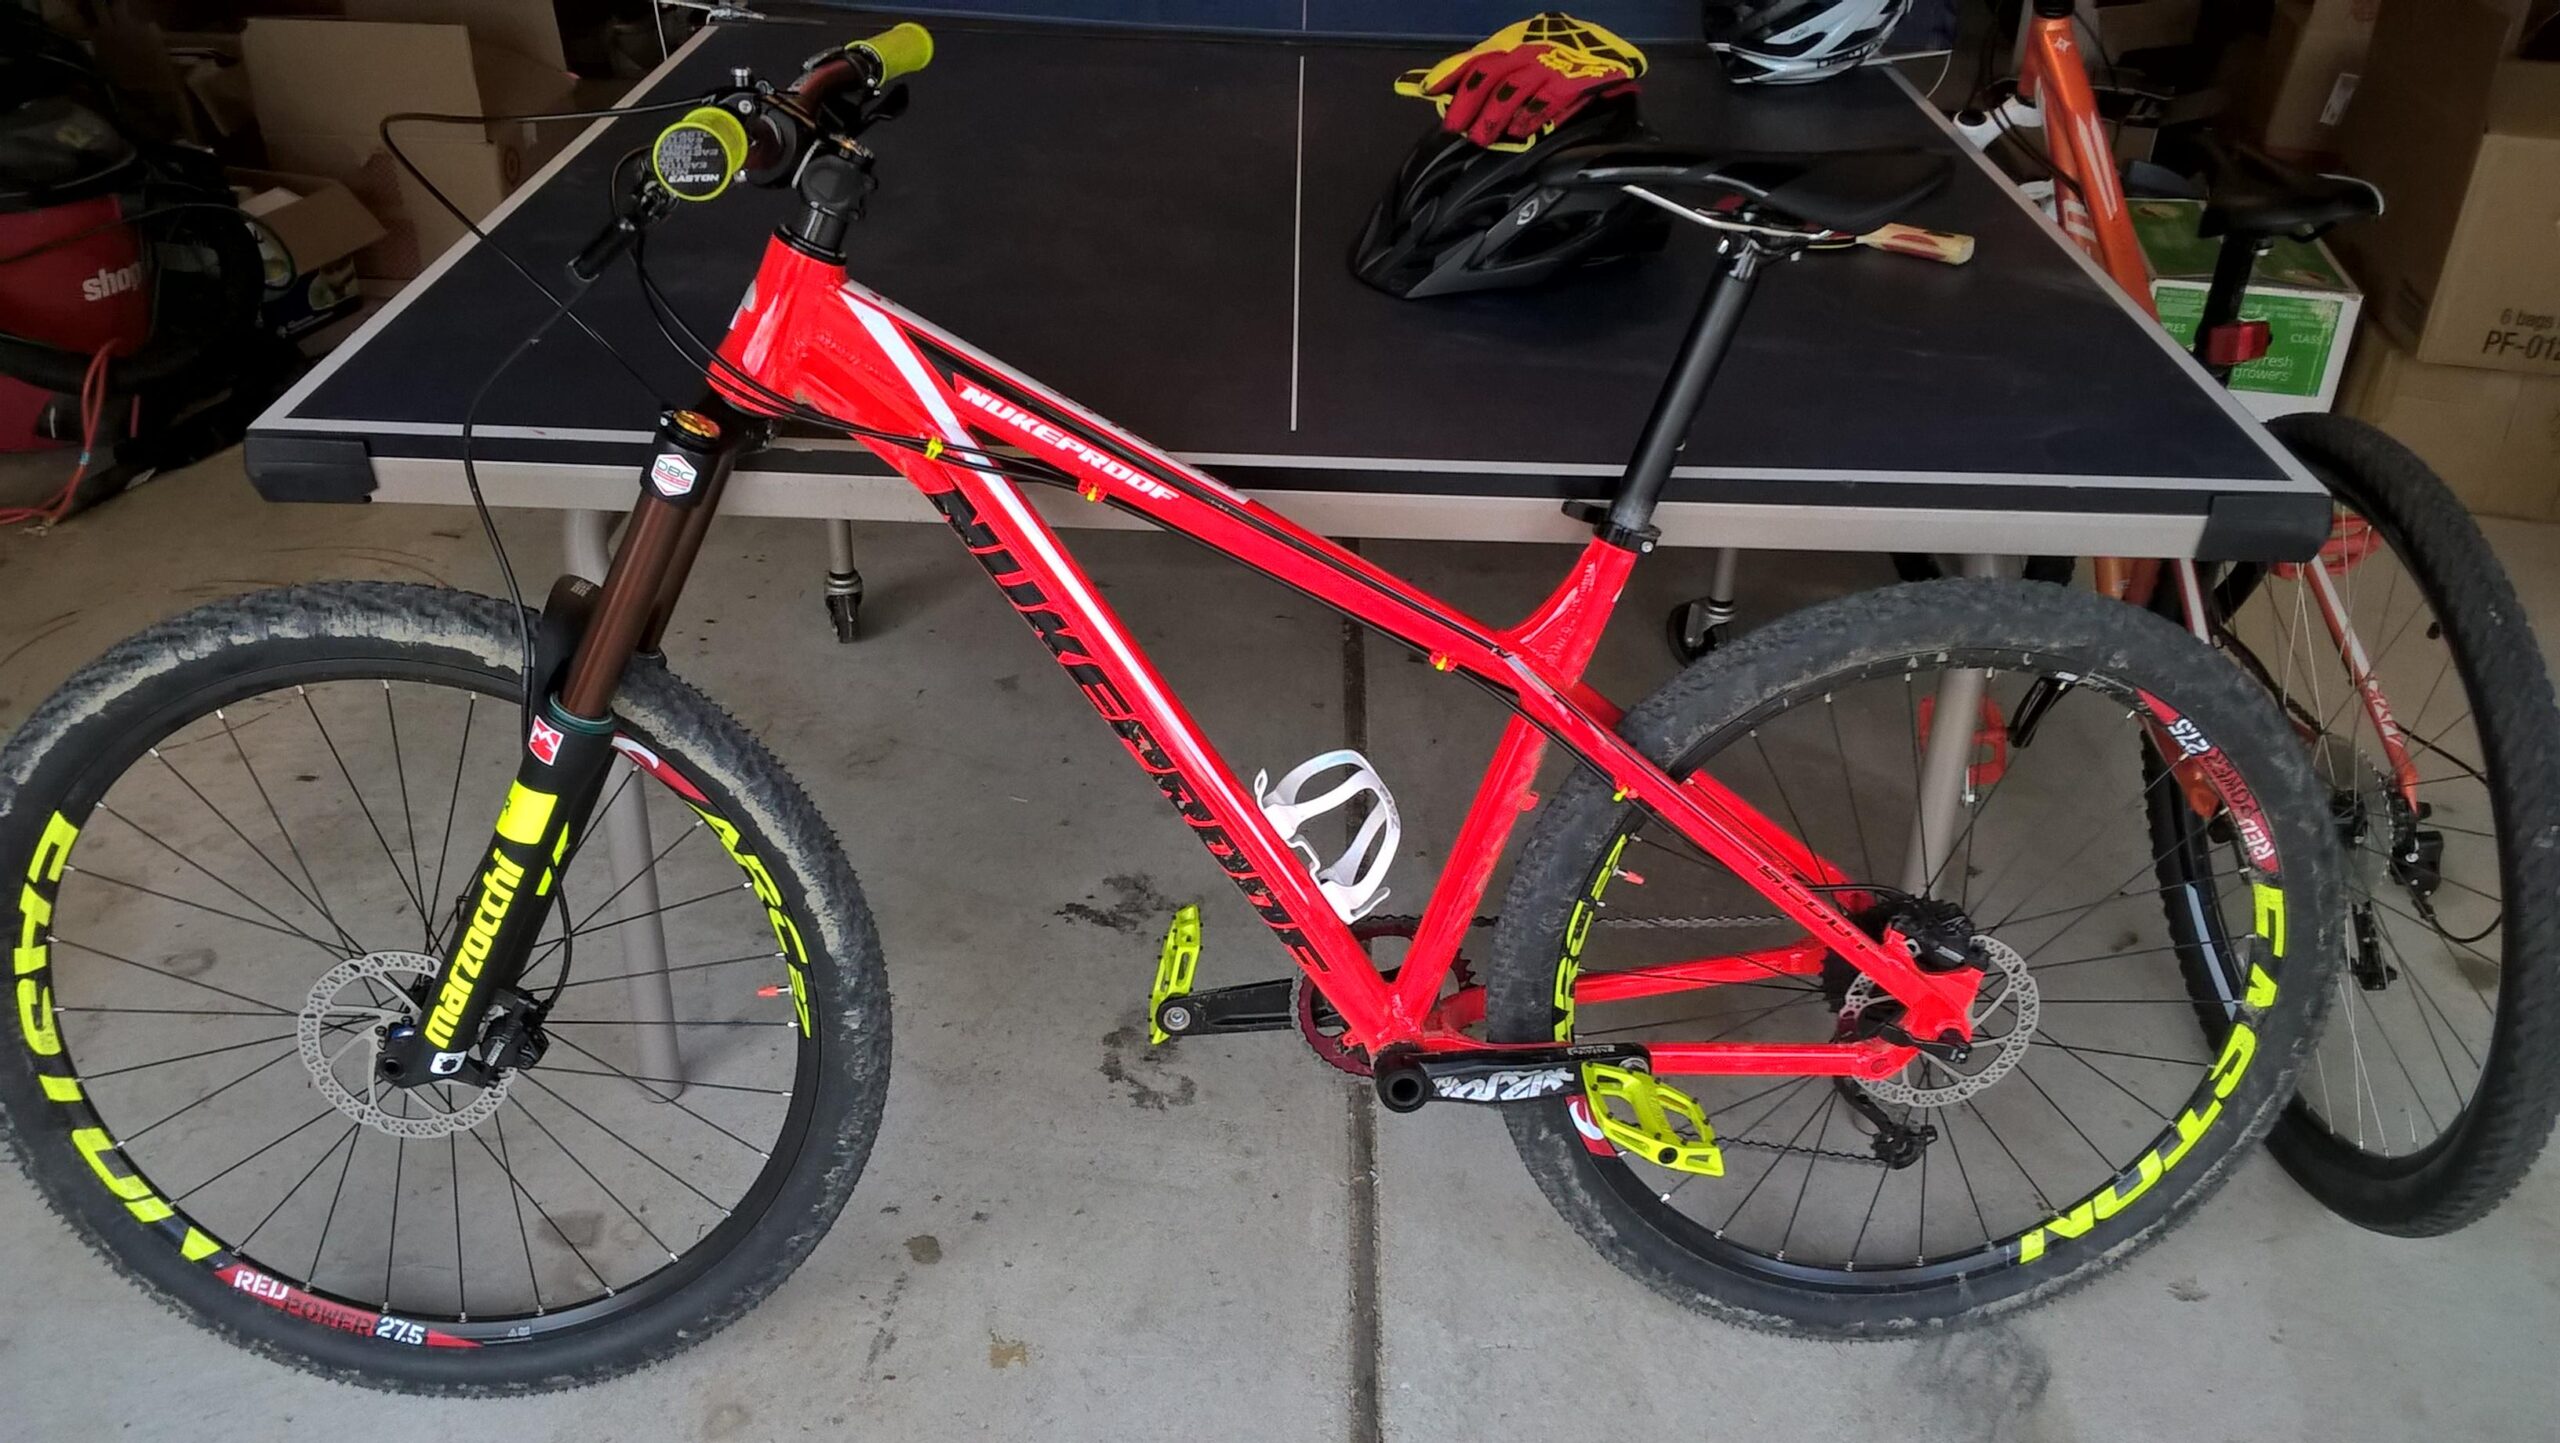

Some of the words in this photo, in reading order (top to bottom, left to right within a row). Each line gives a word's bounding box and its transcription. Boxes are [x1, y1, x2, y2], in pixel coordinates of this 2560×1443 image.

[668, 173, 720, 184] EASTON
[2515, 309, 2554, 332] bags
[656, 459, 695, 482] DBC
[959, 386, 1181, 501] NUKEPROOF
[2237, 816, 2276, 862] RED
[1757, 864, 1867, 950] SCOUT
[424, 848, 525, 1050] marzocchi
[14, 810, 222, 1262] EASTON
[2019, 882, 2287, 1264] EASTON
[233, 1269, 290, 1301] RED
[376, 1315, 426, 1346] 27.5
